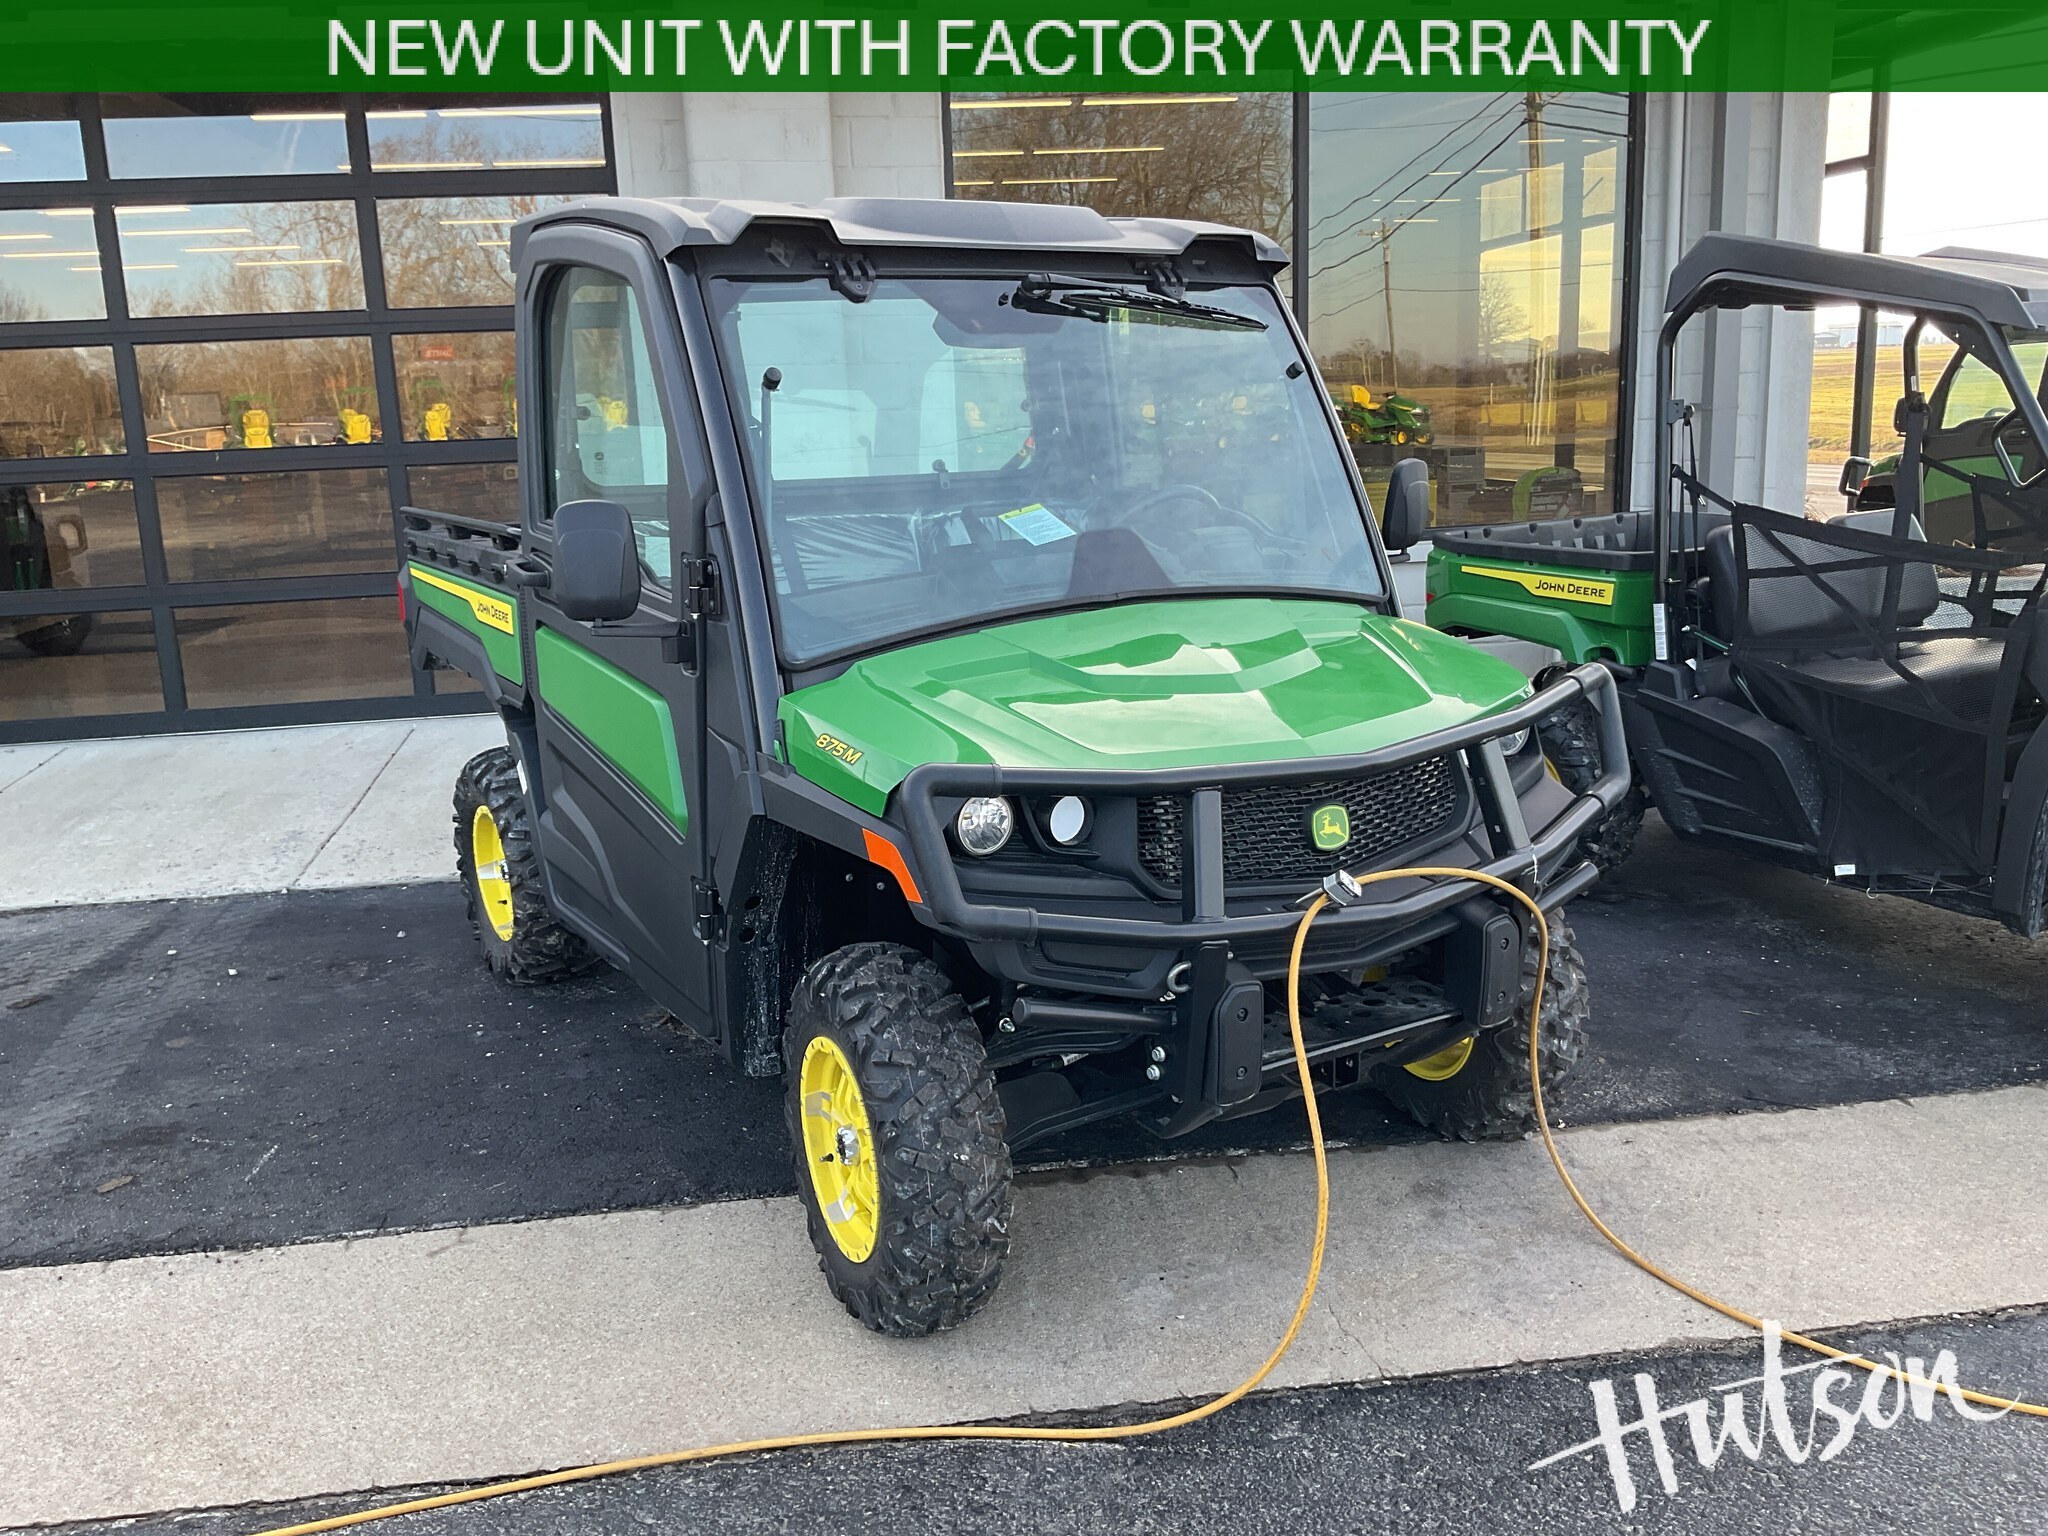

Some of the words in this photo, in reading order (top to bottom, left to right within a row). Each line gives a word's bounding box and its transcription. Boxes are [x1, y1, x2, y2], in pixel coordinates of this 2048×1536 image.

[1535, 579, 1565, 592] JOHN
[1567, 583, 1606, 598] DEERE
[477, 601, 490, 616] JOHN
[491, 605, 509, 624] DEERE
[815, 733, 864, 765] 875M
